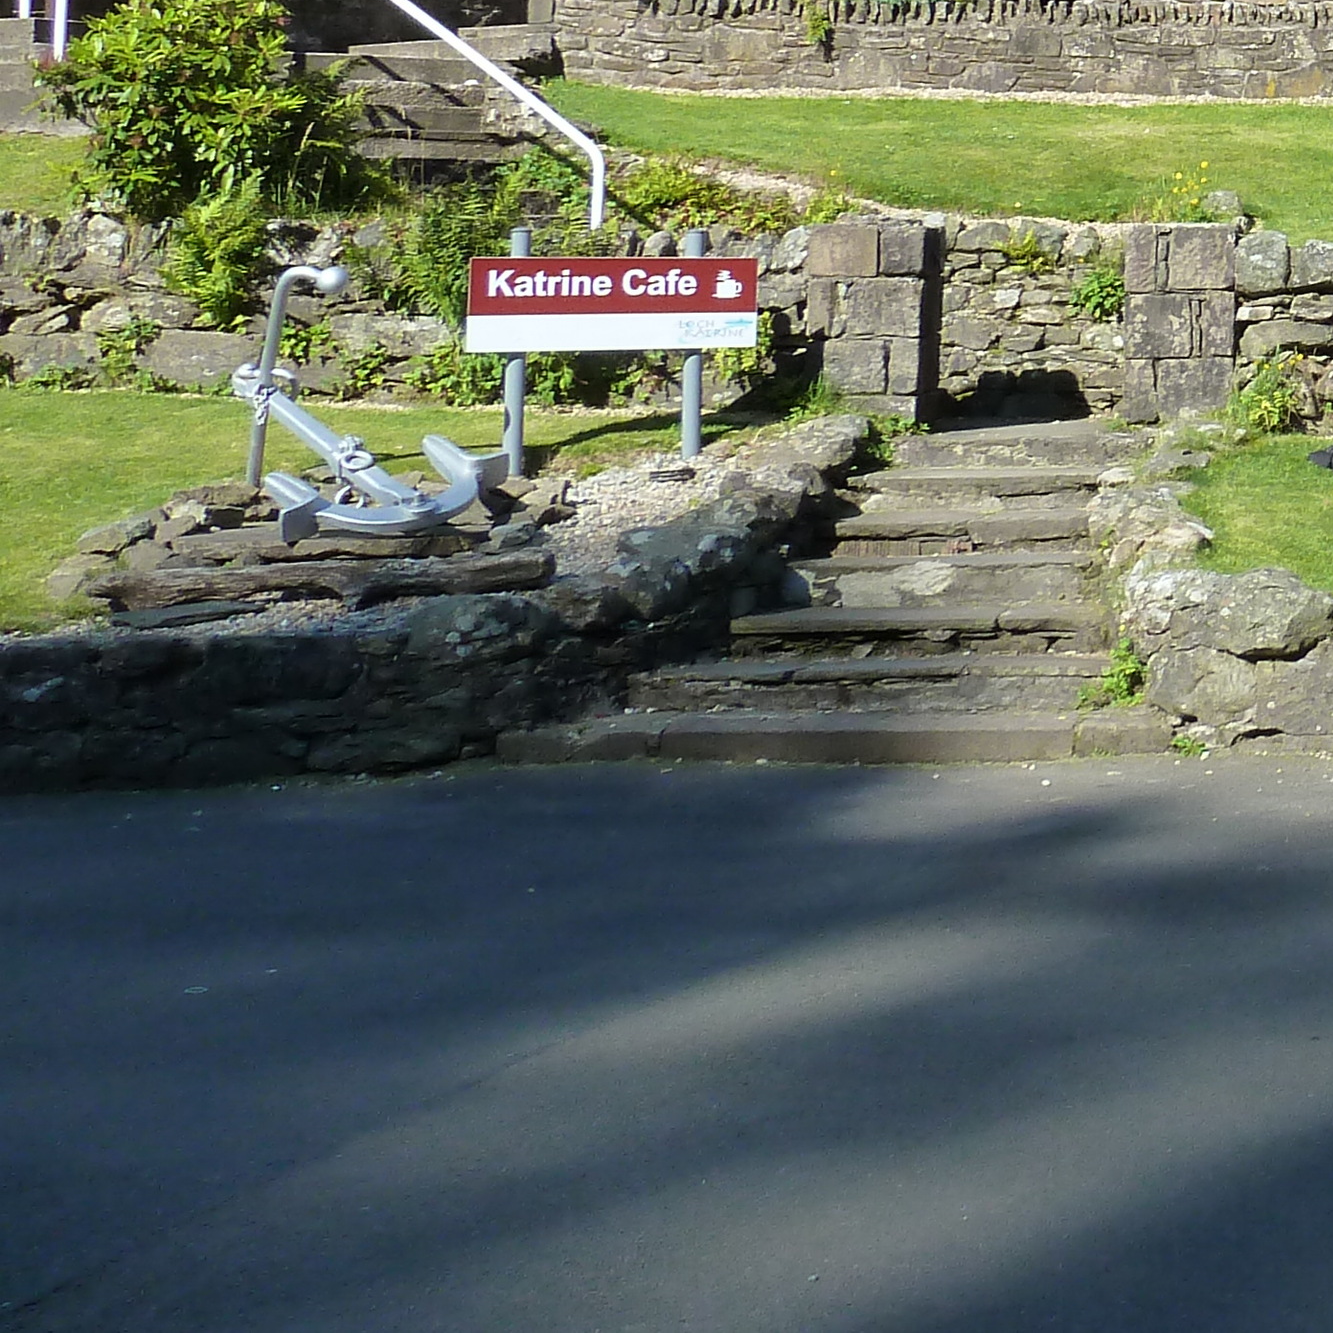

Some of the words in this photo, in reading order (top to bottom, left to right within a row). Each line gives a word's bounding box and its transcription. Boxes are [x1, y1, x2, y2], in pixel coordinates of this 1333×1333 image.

[487, 268, 613, 297] Katrine
[622, 268, 698, 296] Cafe
[678, 320, 715, 329] LOCH
